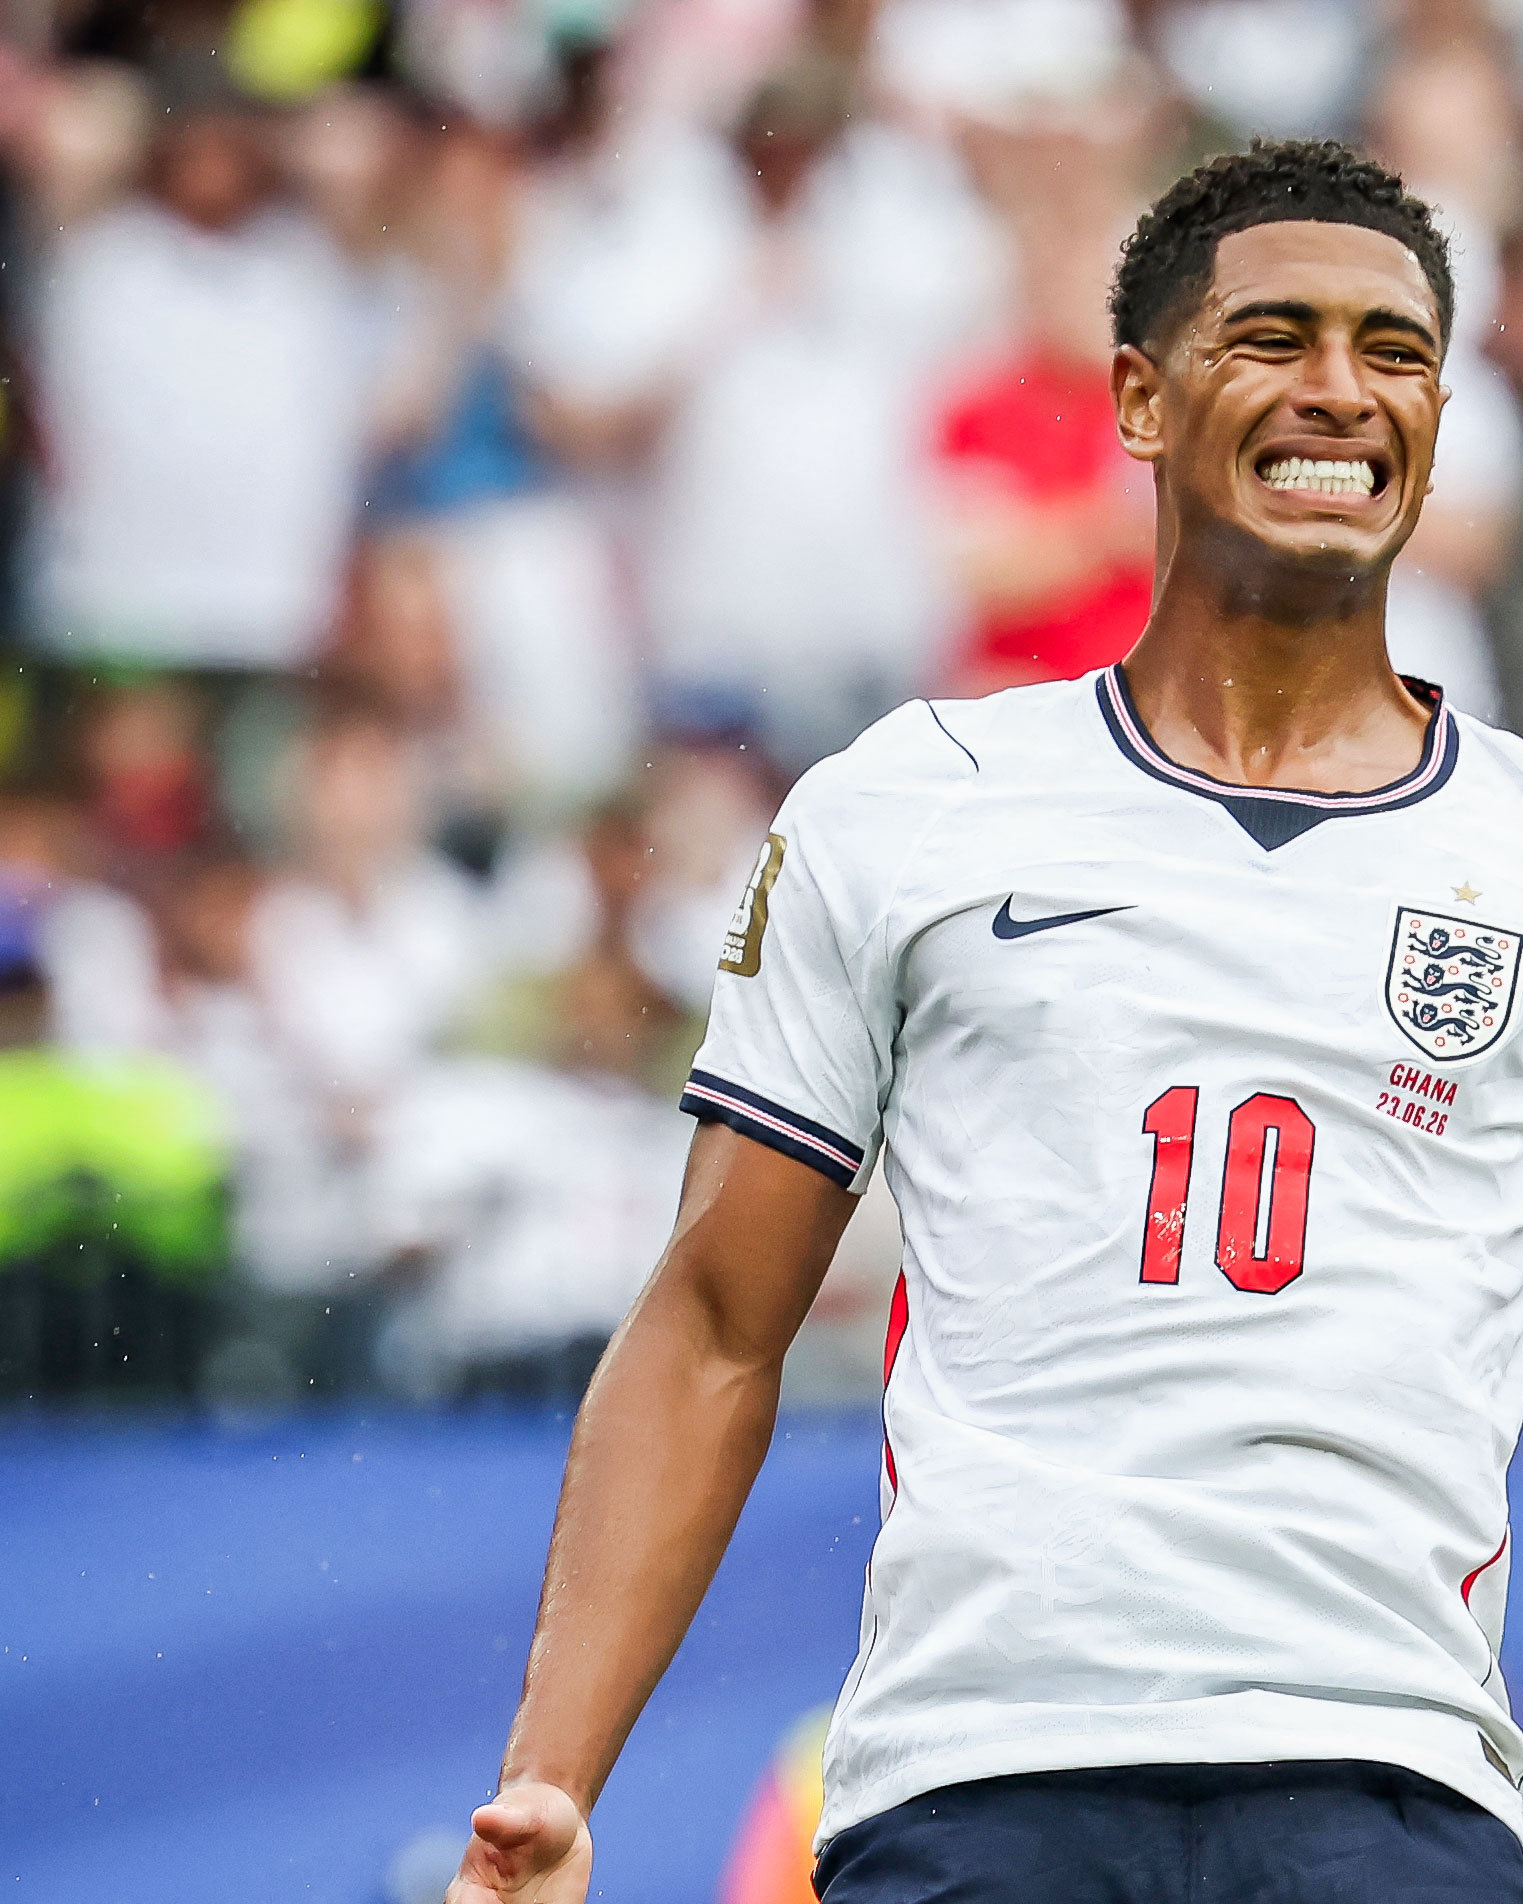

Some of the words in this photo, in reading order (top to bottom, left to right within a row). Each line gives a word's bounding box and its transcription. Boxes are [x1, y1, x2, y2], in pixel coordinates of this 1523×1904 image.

[1389, 1063, 1458, 1107] GHANA
[1375, 1092, 1449, 1136] 23.06.26
[1139, 1085, 1316, 1295] 10
